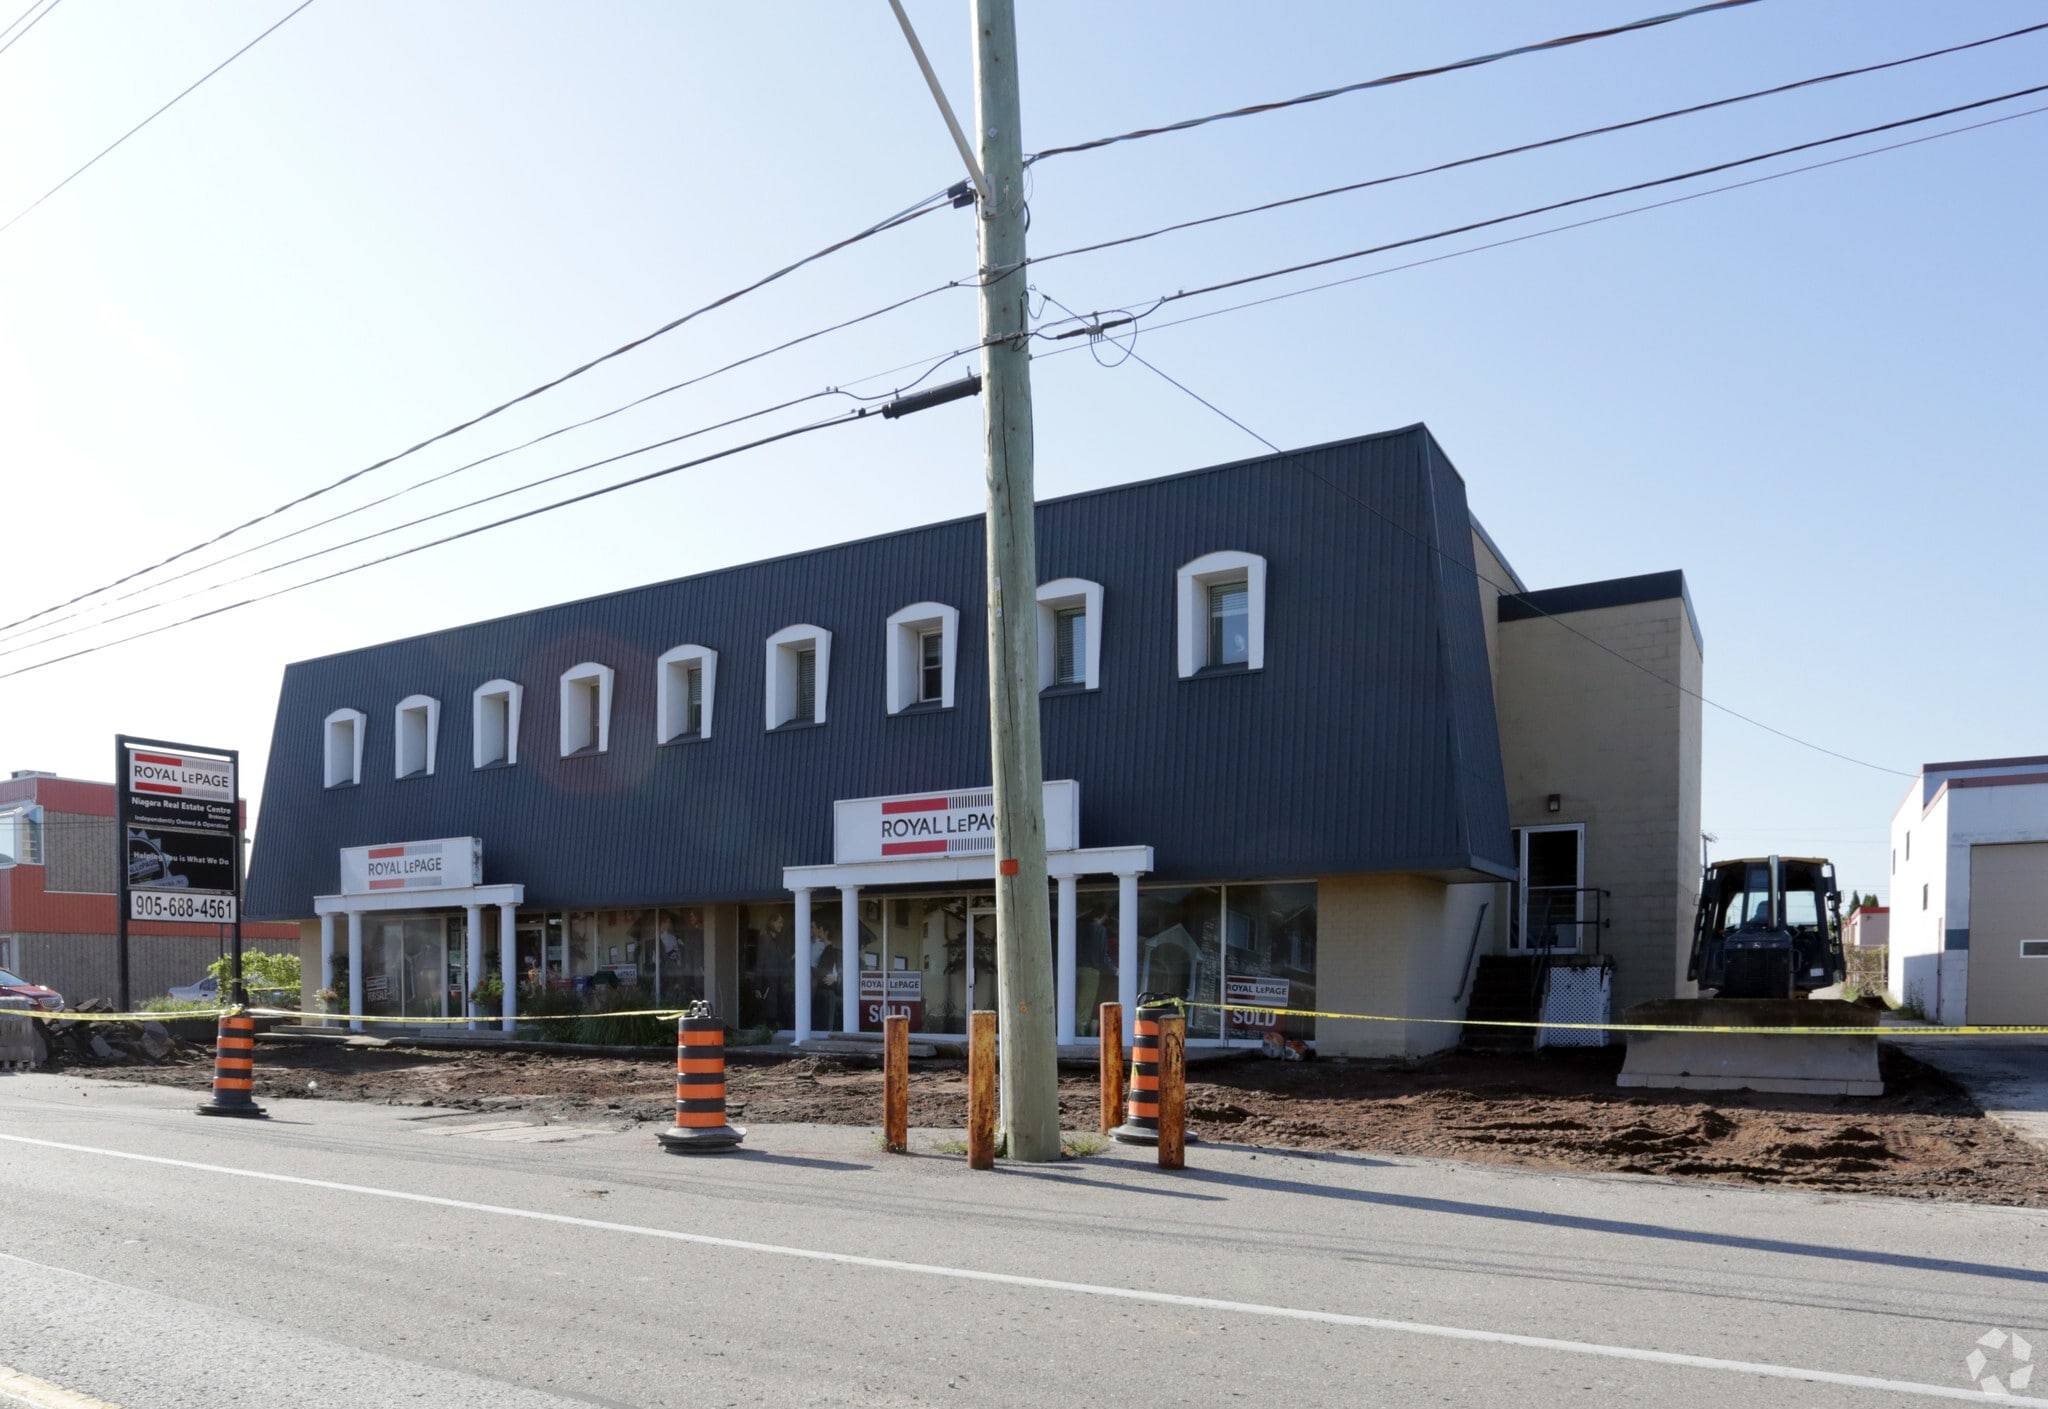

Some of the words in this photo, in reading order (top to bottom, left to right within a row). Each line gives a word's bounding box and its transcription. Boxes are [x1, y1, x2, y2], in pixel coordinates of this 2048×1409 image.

[134, 766, 177, 782] ROYAL
[131, 797, 161, 807] Niagara
[163, 800, 179, 808] Real
[182, 802, 204, 811] Estate
[206, 805, 231, 814] Centre
[134, 815, 175, 825] Independently
[882, 817, 943, 838] ROYAL
[947, 813, 996, 833] LEPA
[134, 852, 163, 861] Helping
[368, 862, 401, 876] ROYAL
[136, 895, 232, 919] 905-688-4561
[1226, 984, 1253, 992] ROYAL
[1232, 1010, 1277, 1027] SOLD
